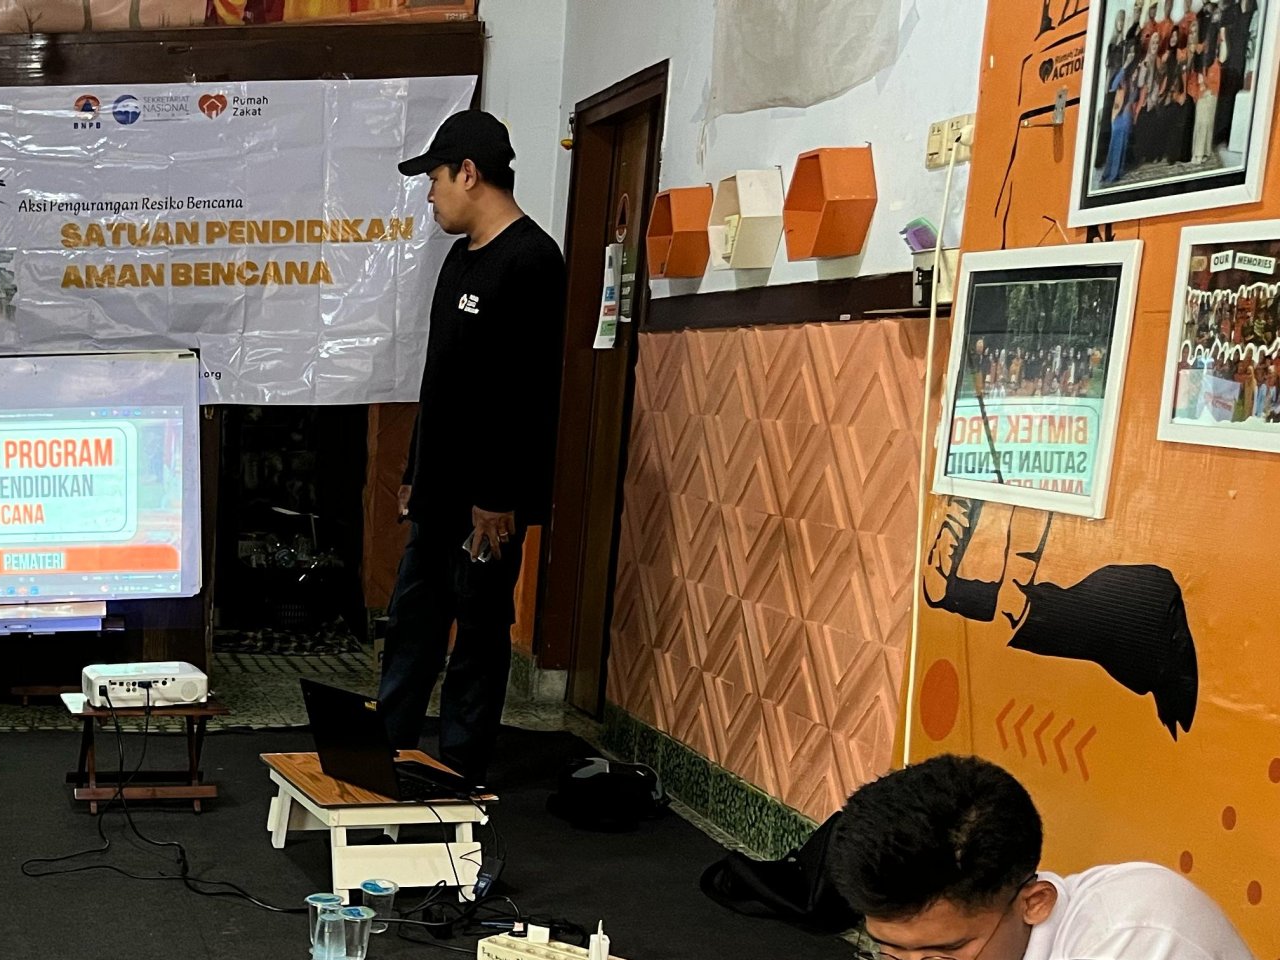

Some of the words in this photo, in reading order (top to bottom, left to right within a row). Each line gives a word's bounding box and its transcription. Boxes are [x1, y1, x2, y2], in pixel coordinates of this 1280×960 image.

[143, 104, 189, 113] NASIONAL
[233, 95, 269, 105] Rumah
[233, 107, 261, 116] Zakat
[18, 198, 47, 213] Aksi
[49, 199, 138, 216] Pengurangan
[142, 197, 183, 210] Resiko
[186, 196, 243, 210] Bencana
[60, 220, 199, 248] SATUAN
[205, 216, 414, 244] PENDIDIKAN
[1213, 253, 1230, 266] OUR
[1237, 255, 1272, 269] MEMORIES
[61, 263, 165, 289] AMAN
[171, 261, 334, 287] BENCANA
[4, 438, 114, 469] PROGRAM
[3, 551, 65, 570] PEMATERI
